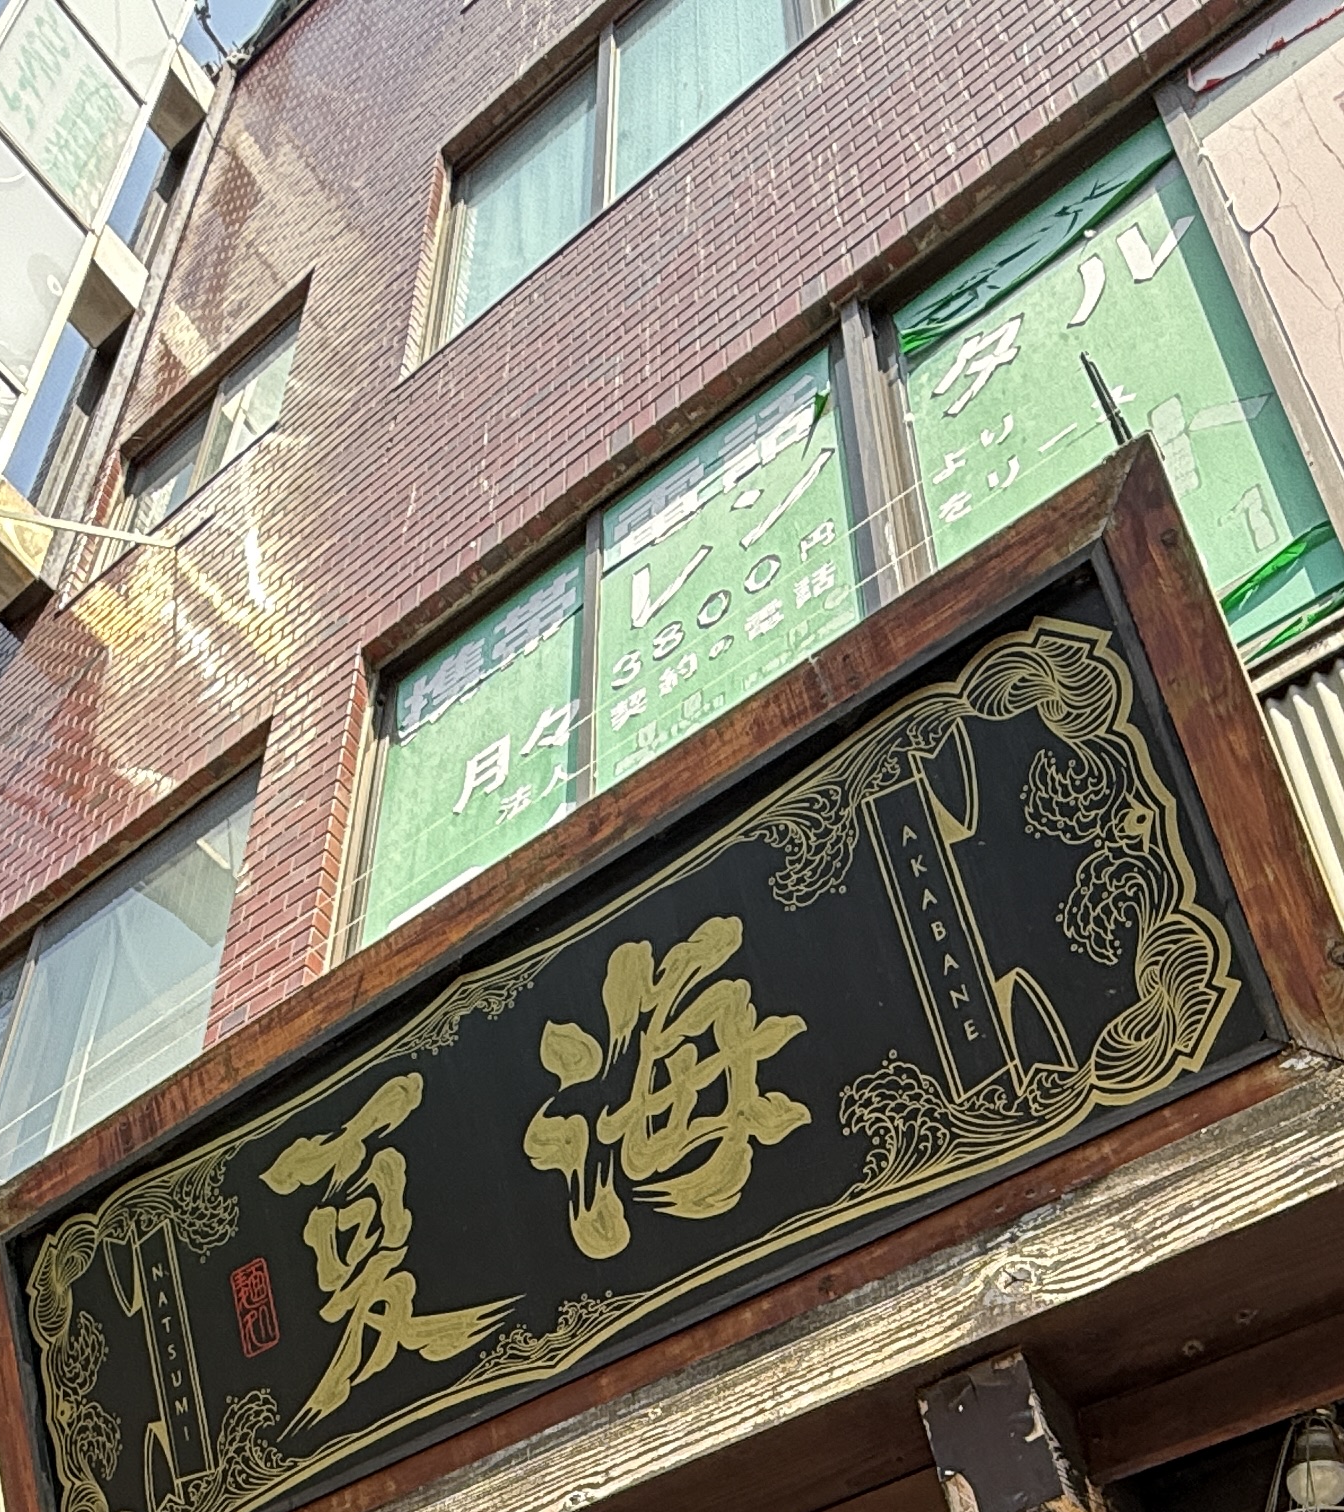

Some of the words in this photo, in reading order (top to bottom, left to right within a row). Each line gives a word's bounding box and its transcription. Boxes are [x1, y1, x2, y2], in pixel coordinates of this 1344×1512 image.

[901, 824, 981, 1042] AKABANE
[259, 915, 812, 1443] 夏海
[152, 1263, 190, 1442] NATSUMI
